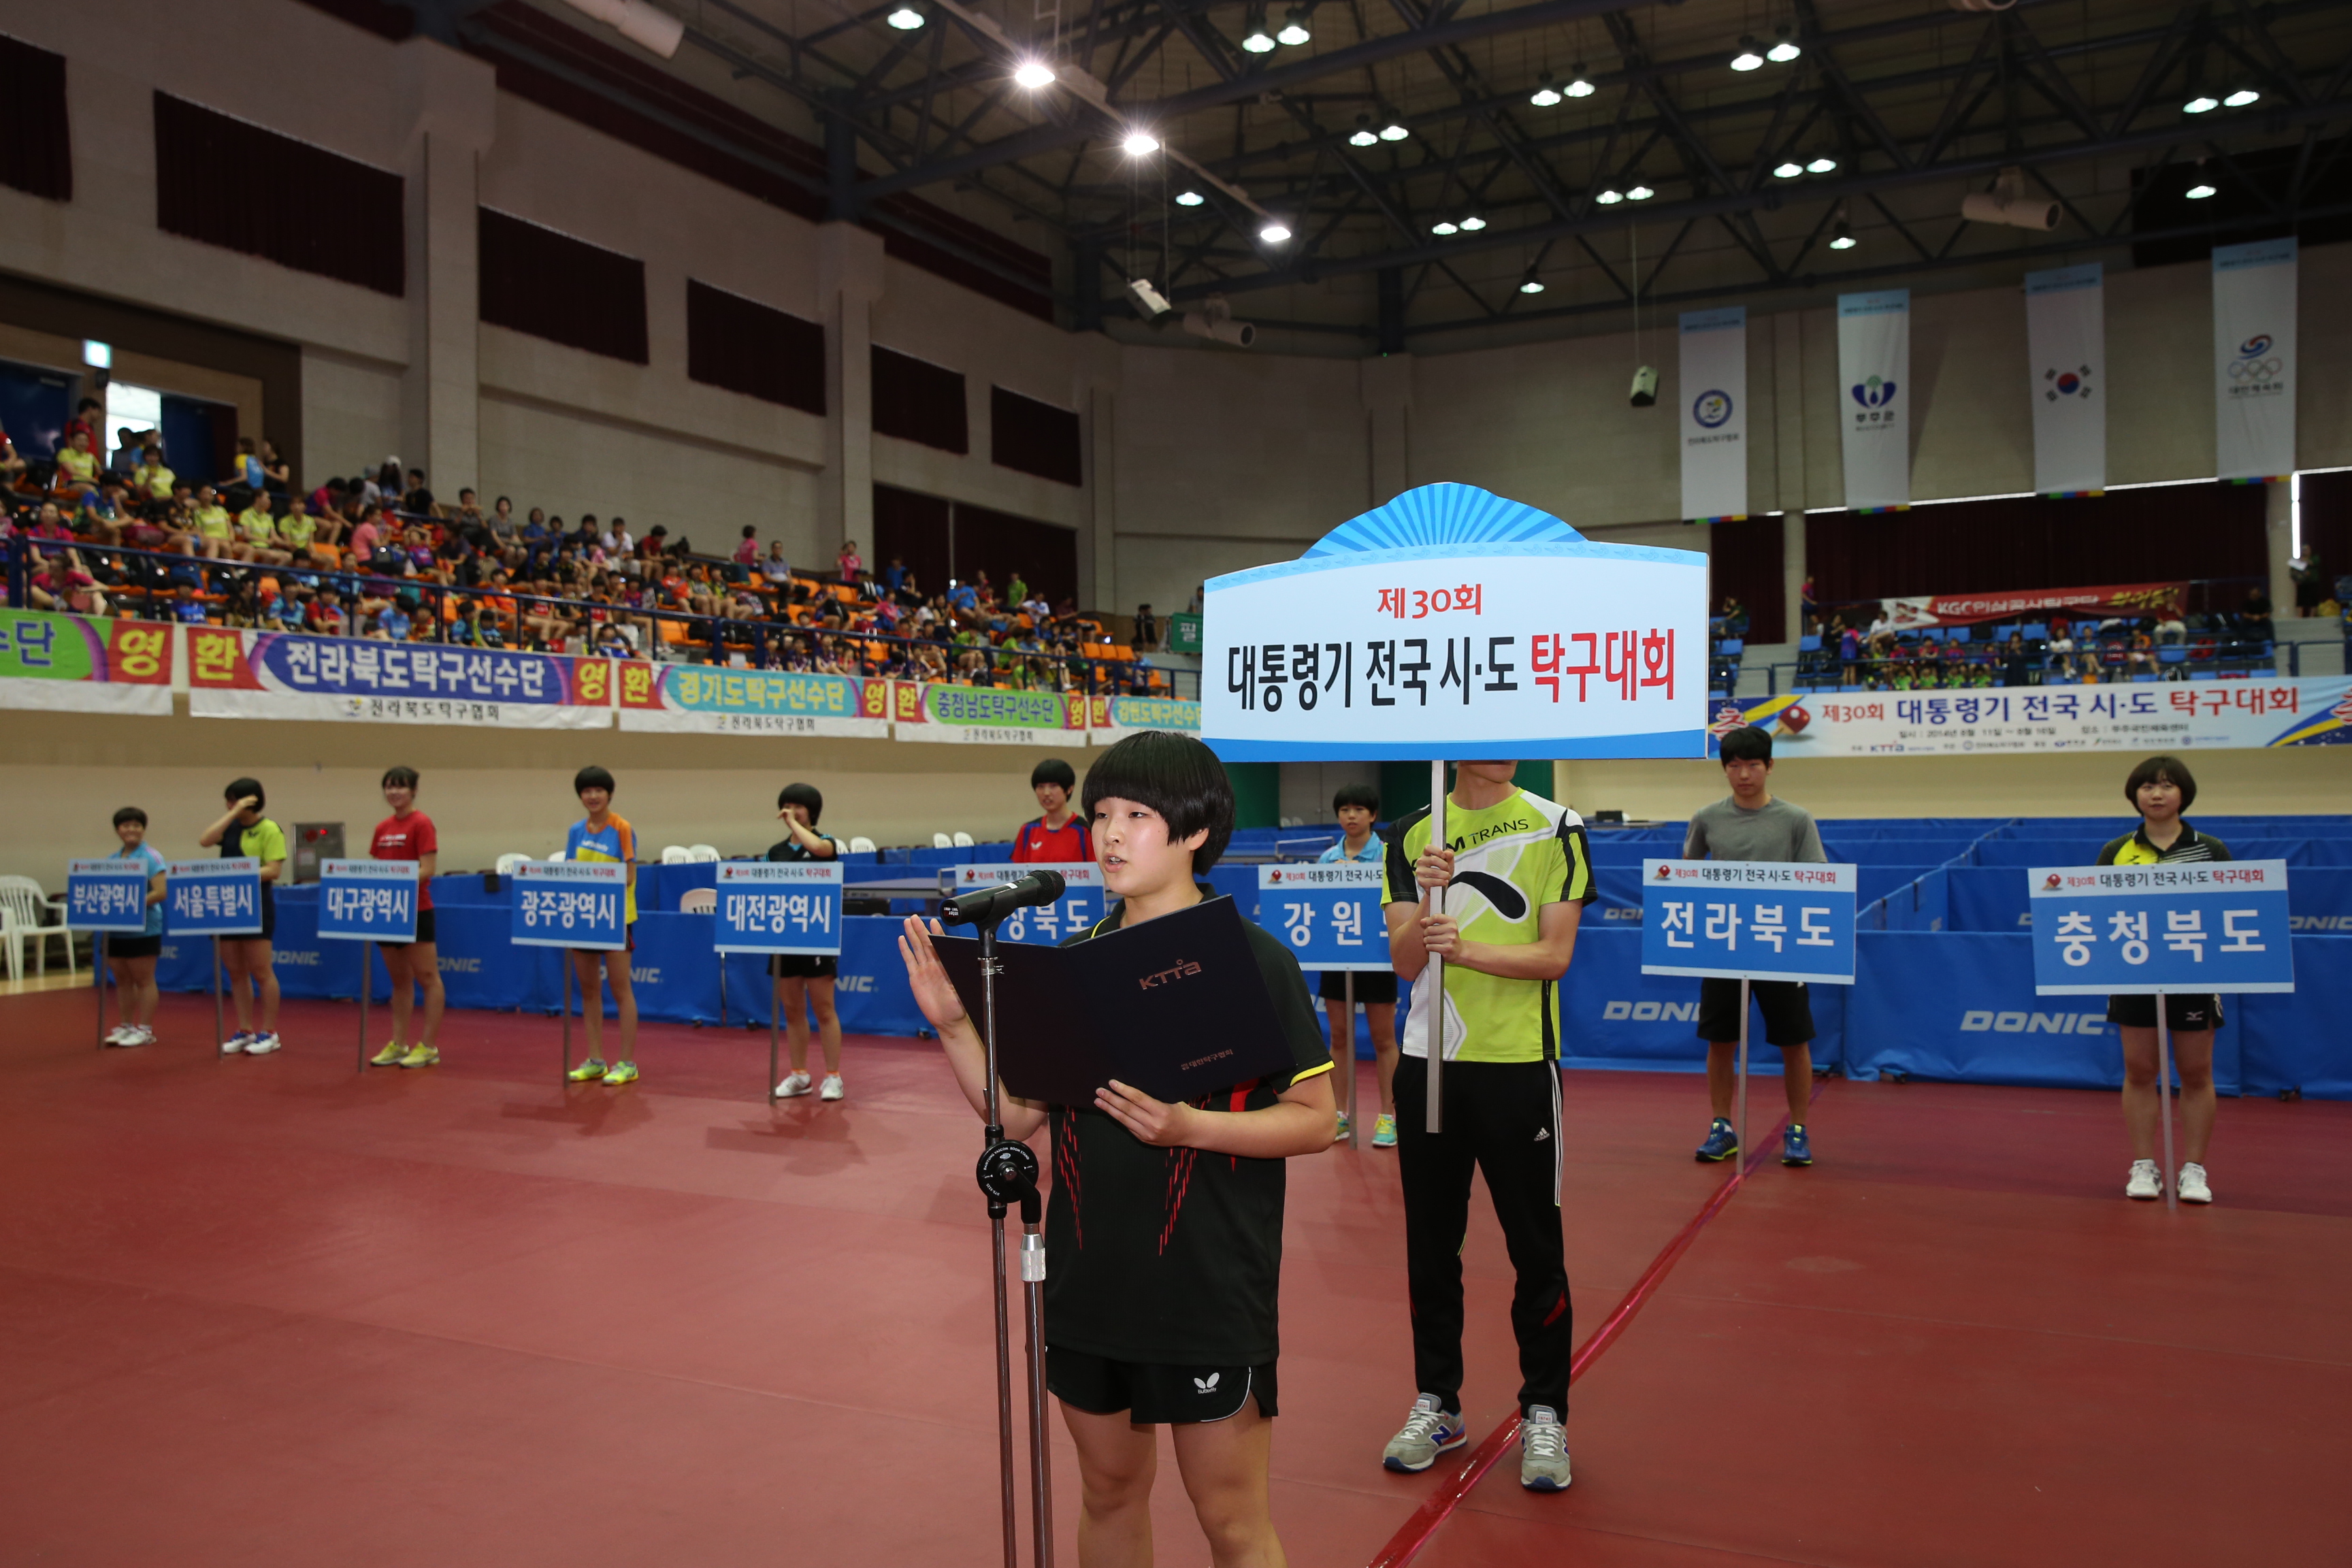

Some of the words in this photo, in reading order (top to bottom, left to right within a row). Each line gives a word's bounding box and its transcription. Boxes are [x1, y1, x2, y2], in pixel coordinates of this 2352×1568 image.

[1377, 583, 1482, 619] 제30회
[0, 621, 56, 667] 단
[118, 628, 166, 677] 영
[195, 633, 240, 681] 환
[285, 640, 546, 698] 전라북도탁구선수단
[578, 662, 607, 701] 영
[1228, 640, 1353, 713] 대통령기
[1365, 636, 1431, 706] 전국
[1439, 636, 1518, 706] 시·도
[1531, 628, 1675, 704] 탁구대회
[623, 665, 653, 703] 환
[678, 672, 845, 712] 경기도탁구선수단
[865, 683, 884, 715] 영
[897, 686, 917, 719] 환
[937, 691, 1055, 724] 충청남도탁구선수단
[1071, 700, 1083, 727] 영
[1822, 703, 1884, 723] 제30회
[1897, 696, 2010, 725] 대통령기
[2023, 693, 2081, 721] 전국
[2170, 687, 2299, 718] 탁구대회
[1469, 819, 1529, 845] TRANS
[1309, 870, 1343, 882] 대통령기
[1345, 870, 1362, 881] 전국
[1675, 868, 1699, 879] 제30회
[1701, 868, 1742, 883] 대통령기
[1745, 869, 1765, 883] 전국
[1794, 870, 1837, 884] 탁구대회
[2100, 872, 2149, 888] 대통령기
[2153, 871, 2178, 886] 전국
[2212, 869, 2264, 885] 탁구대회
[72, 883, 140, 916] 부산광역시
[174, 883, 254, 919] 서울특별시
[327, 886, 409, 924] 대구광역시
[520, 889, 616, 930] 광주광역시
[725, 894, 832, 934] 대전광역시
[1661, 900, 1835, 953] 전라북도
[2053, 909, 2266, 967] 충청북도
[1959, 1010, 2108, 1036] DONIC
